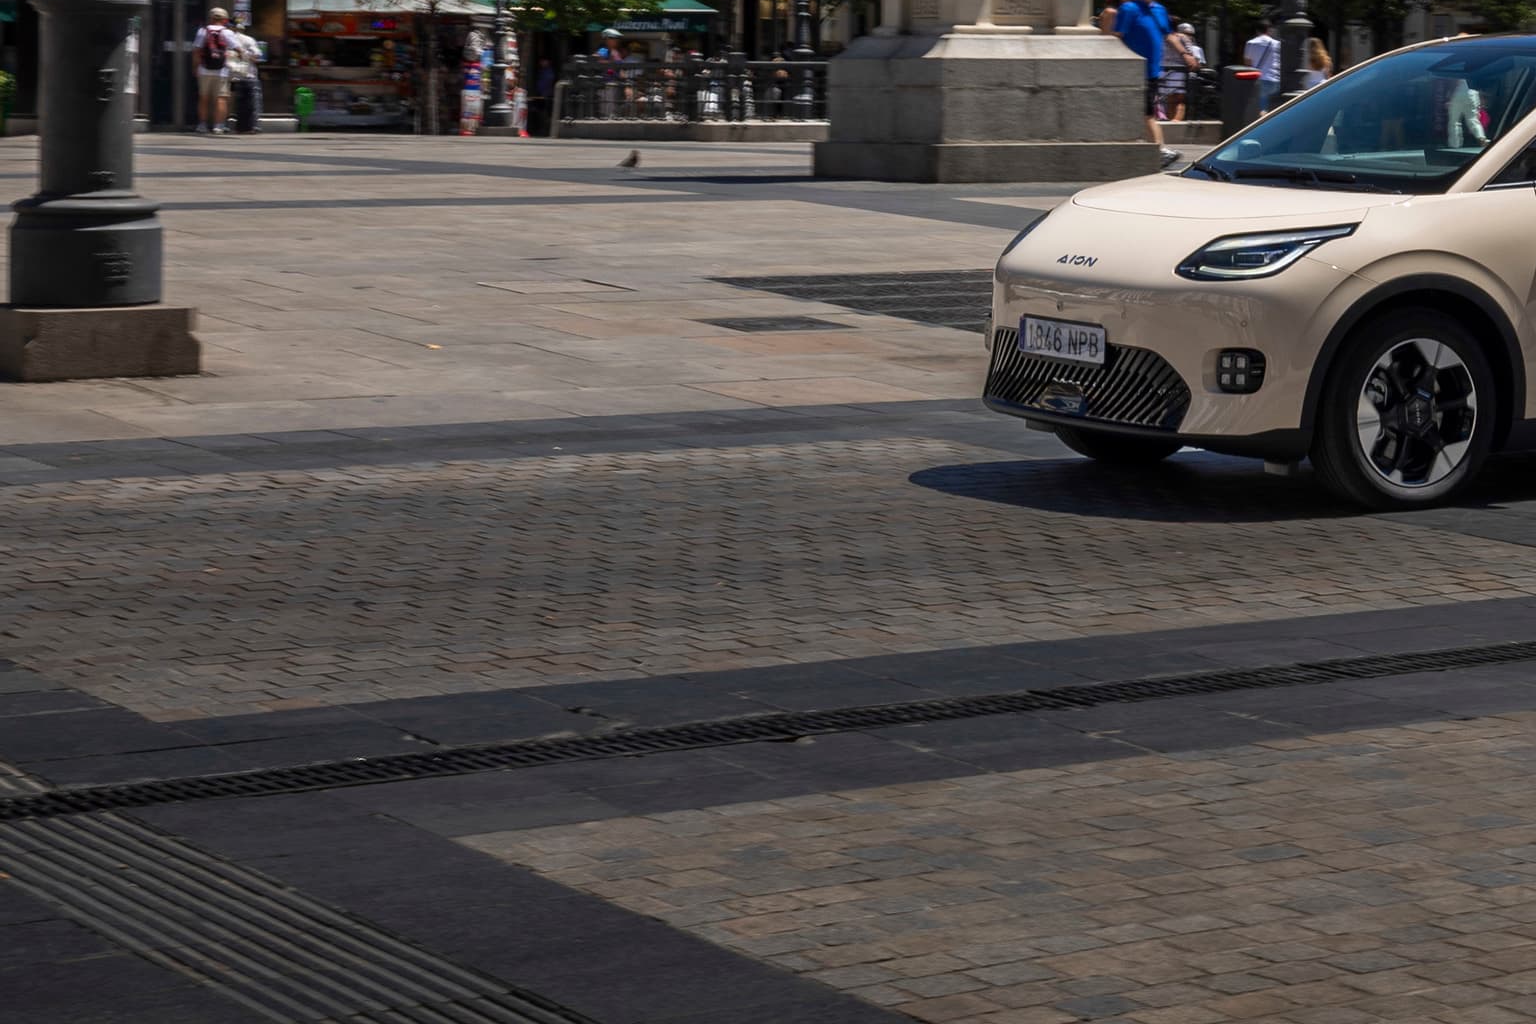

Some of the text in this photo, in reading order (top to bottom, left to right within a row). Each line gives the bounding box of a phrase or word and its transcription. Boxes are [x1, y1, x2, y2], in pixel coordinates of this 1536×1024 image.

[1057, 254, 1098, 267] AION
[1028, 323, 1099, 357] 1846 NPB
